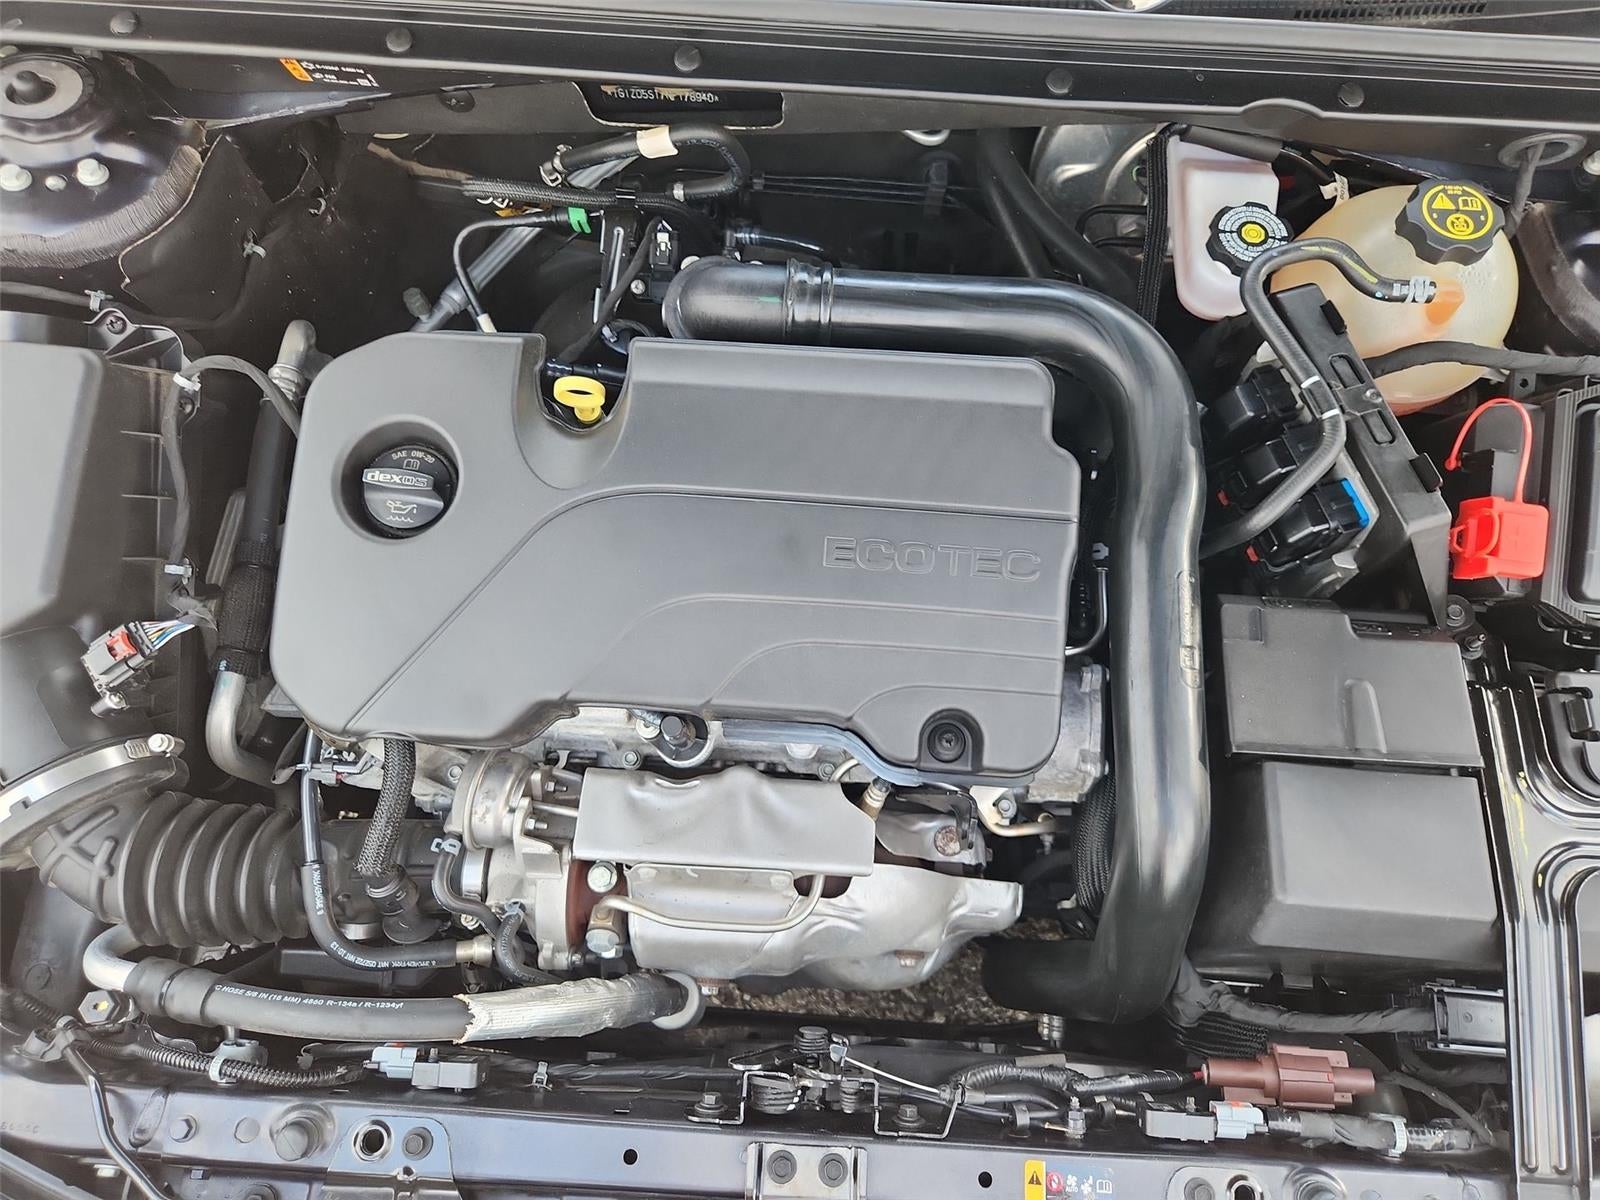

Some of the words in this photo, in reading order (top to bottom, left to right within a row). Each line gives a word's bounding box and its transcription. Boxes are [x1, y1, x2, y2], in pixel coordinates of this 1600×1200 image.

[391, 450, 408, 461] SAE
[411, 450, 435, 464] 0W-20
[366, 470, 428, 488] dexos
[823, 536, 1041, 582] ECOTEC
[221, 985, 246, 995] HOSE
[244, 990, 259, 998] 5/8
[282, 995, 302, 1004] MM)
[326, 999, 358, 1008] R-134a
[1065, 1185, 1079, 1193] AUTO
